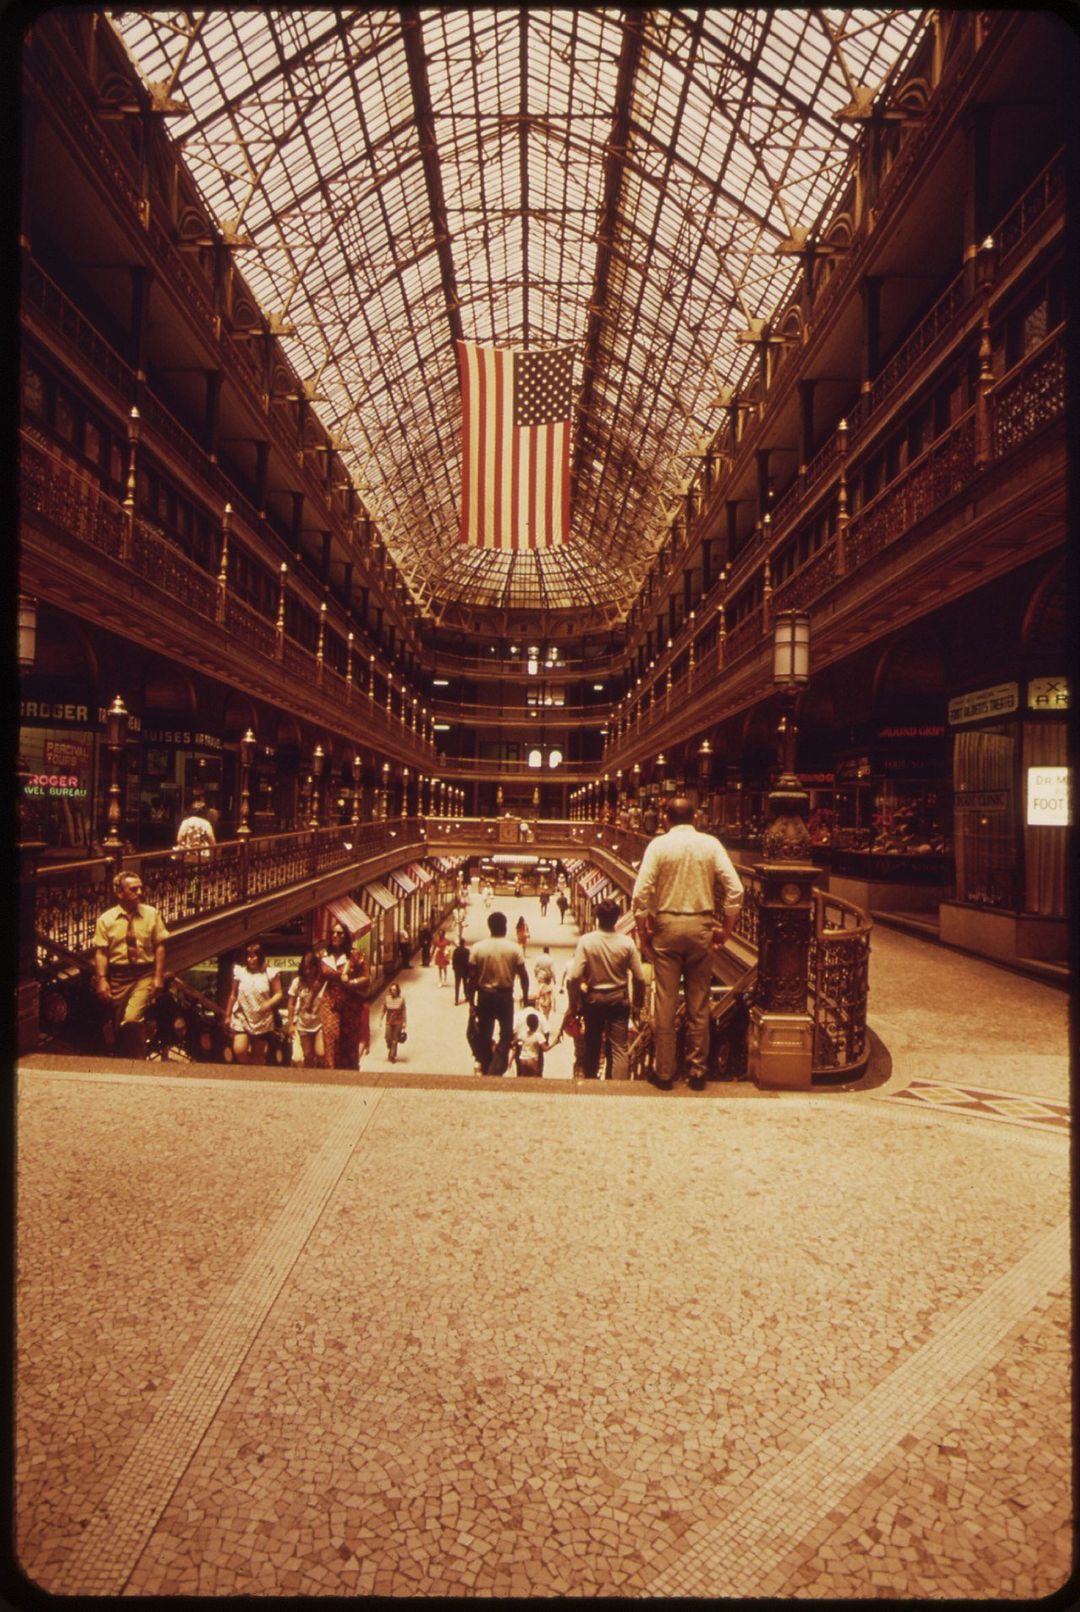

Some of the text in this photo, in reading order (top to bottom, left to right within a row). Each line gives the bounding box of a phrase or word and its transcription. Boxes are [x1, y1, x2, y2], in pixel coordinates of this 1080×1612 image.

[29, 774, 79, 787] ROGER
[49, 787, 88, 798] BUREAU
[1033, 798, 1064, 810] FOOT
